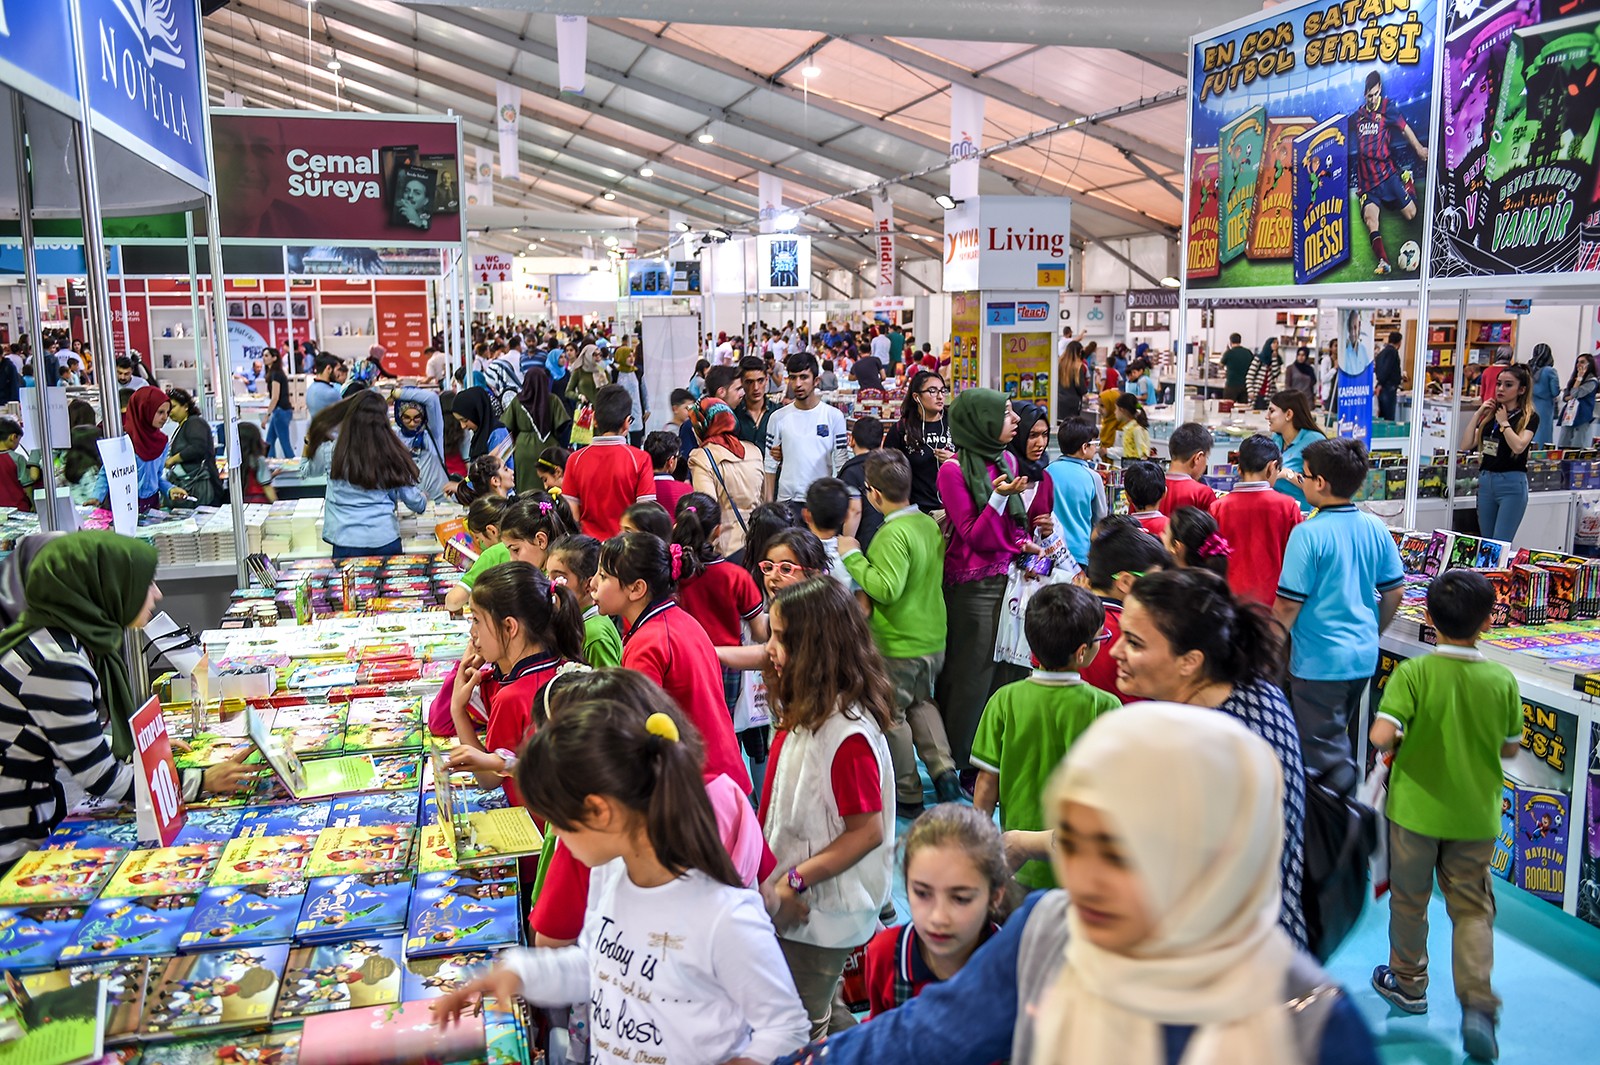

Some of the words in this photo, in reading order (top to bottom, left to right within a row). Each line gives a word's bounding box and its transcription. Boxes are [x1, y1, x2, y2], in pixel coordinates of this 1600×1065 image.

[1204, 40, 1235, 72] EN
[1241, 22, 1294, 61] ÇOK
[1304, 0, 1410, 38] SATAN
[1200, 50, 1295, 102] FUTBOL
[1305, 12, 1422, 66] SERİSİ
[99, 18, 192, 145] NOVELLA
[286, 148, 380, 174] Cemal
[1462, 151, 1489, 188] BEYA
[288, 172, 380, 203] Süreya
[1499, 170, 1534, 202] BEYAZ
[1535, 167, 1582, 192] KANATLI
[1303, 196, 1342, 232] HAYALİM
[1492, 189, 1574, 253] VAMPİR
[960, 228, 979, 248] YUVA
[988, 228, 1064, 258] Living
[1304, 218, 1342, 272] MESSI
[474, 263, 511, 271] LAVABO
[485, 255, 500, 263] WC
[1044, 272, 1050, 283] 3
[994, 311, 1000, 322] 2
[1010, 336, 1027, 353] 20
[1338, 385, 1370, 398] KAHRAMAN
[112, 464, 135, 479] KİTAPLAR
[125, 484, 131, 495] 10
[127, 503, 133, 512] TL
[150, 760, 178, 828] 10
[1525, 846, 1564, 865] HAYALİM
[1525, 866, 1564, 893] RONALDO
[595, 916, 634, 976] Today
[640, 954, 658, 982] is
[592, 988, 612, 1030] the
[616, 998, 663, 1046] best
